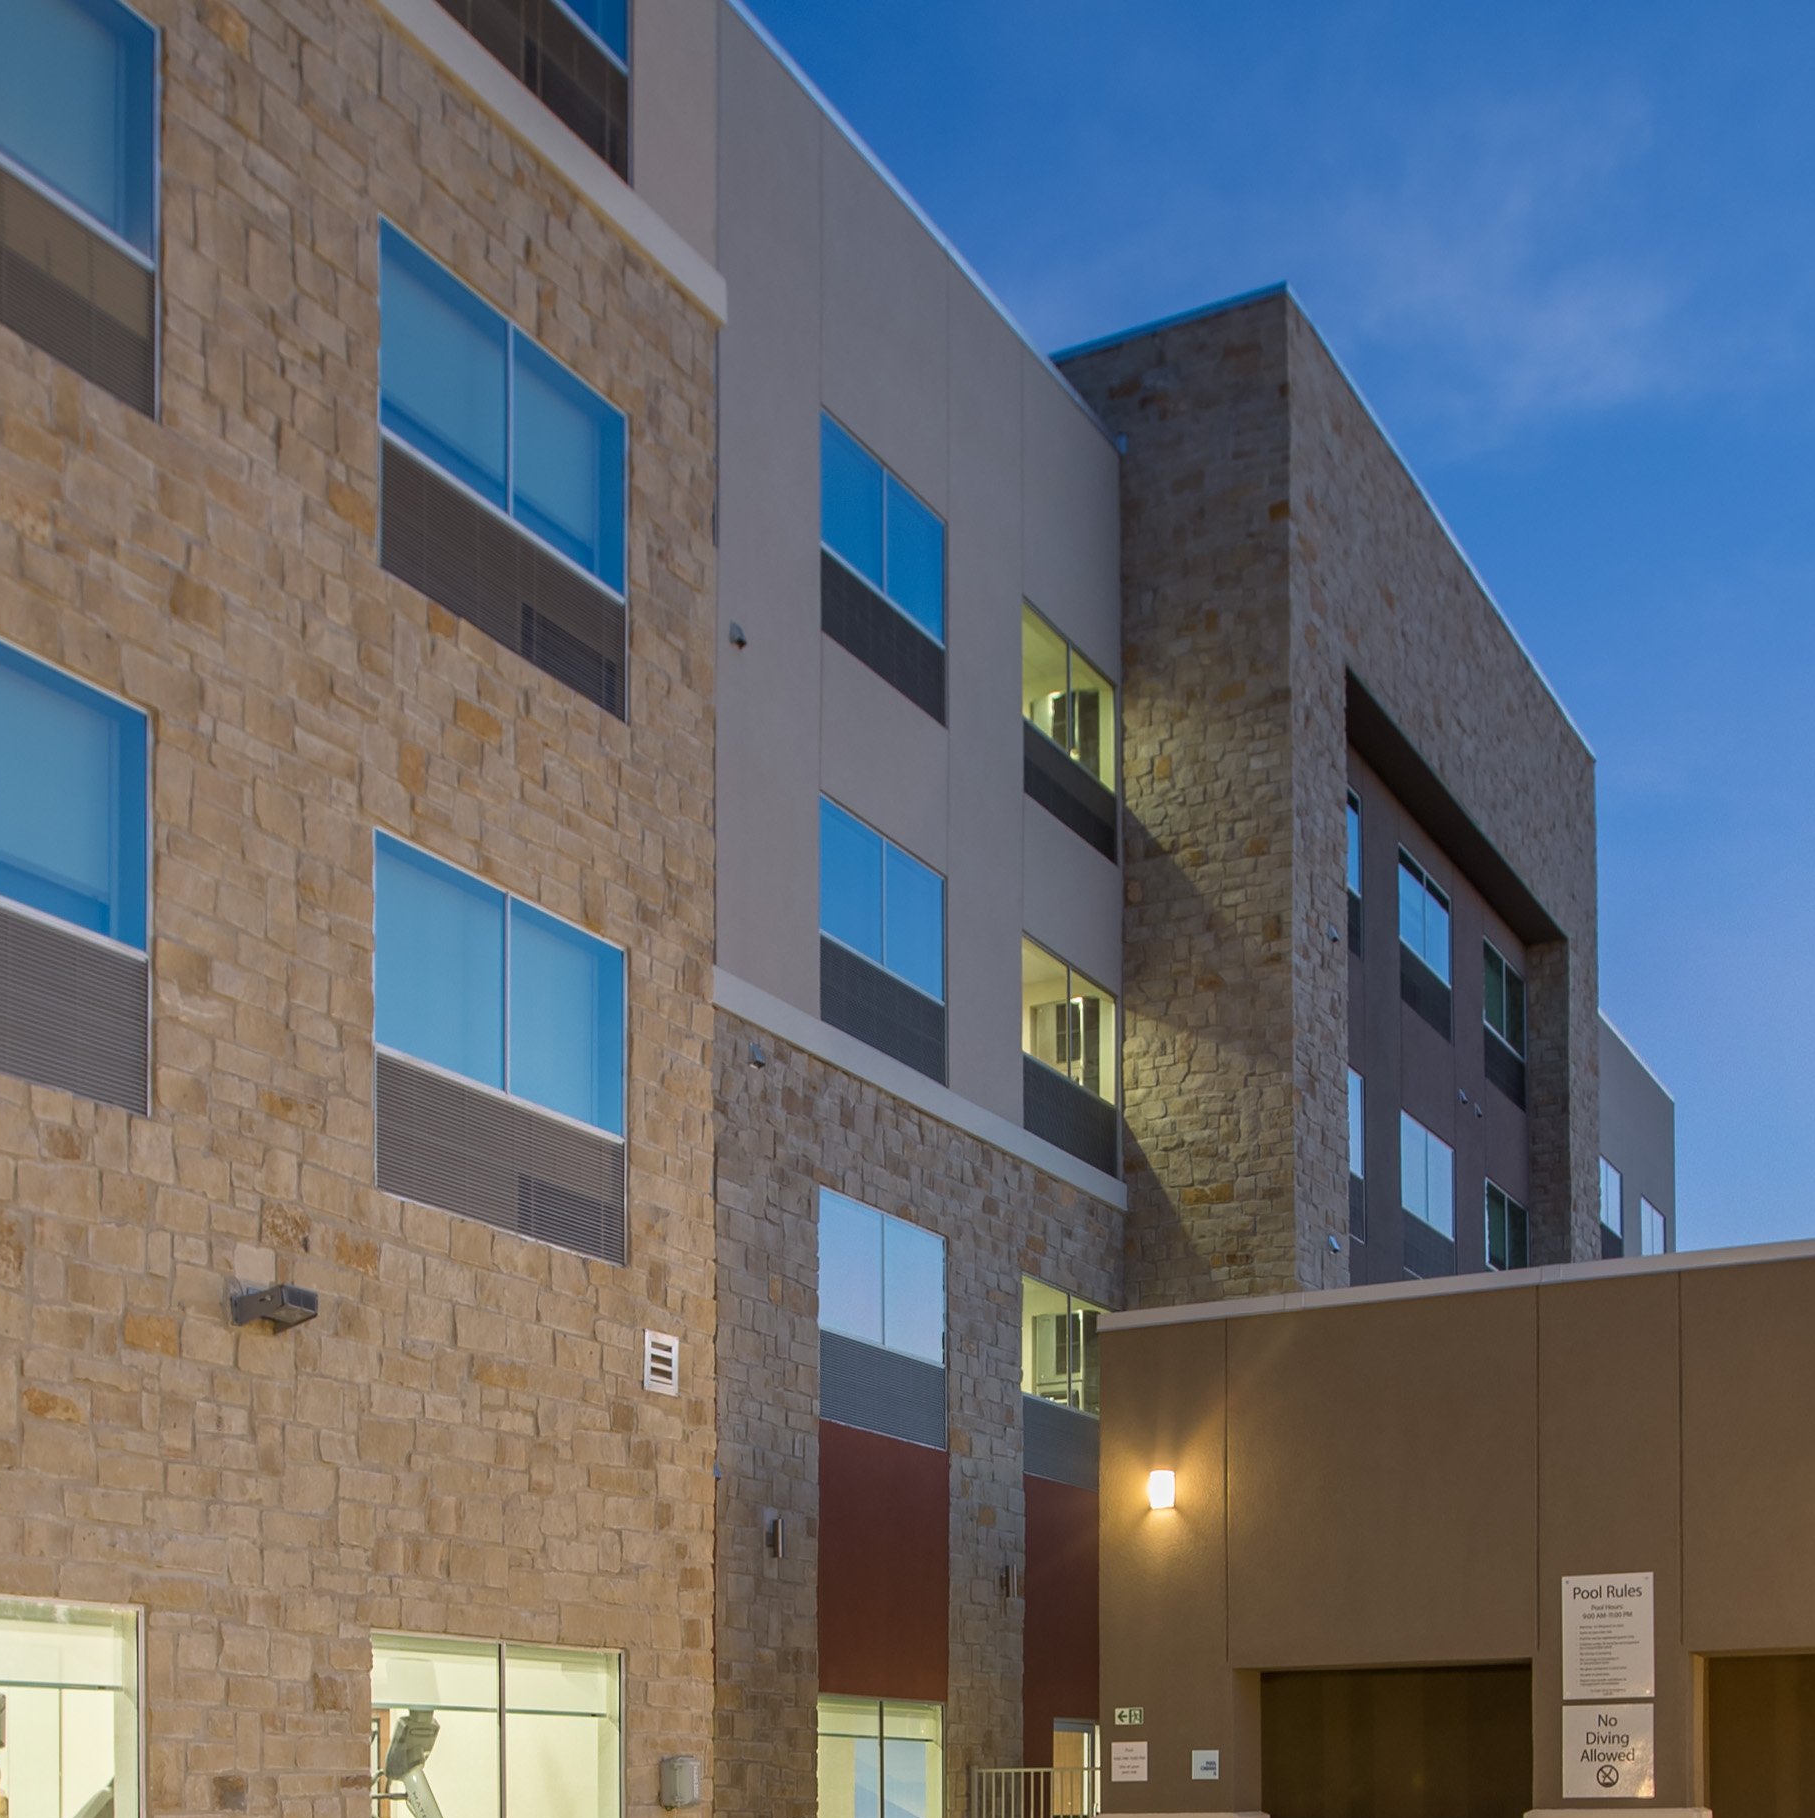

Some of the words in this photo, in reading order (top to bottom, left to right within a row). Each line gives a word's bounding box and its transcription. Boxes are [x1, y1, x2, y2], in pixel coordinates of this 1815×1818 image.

[1573, 1585, 1602, 1600] Pool
[1606, 1583, 1642, 1599] Rules
[1597, 1714, 1618, 1728] No
[1585, 1731, 1630, 1748] Diving
[1580, 1748, 1636, 1763] Allowed
